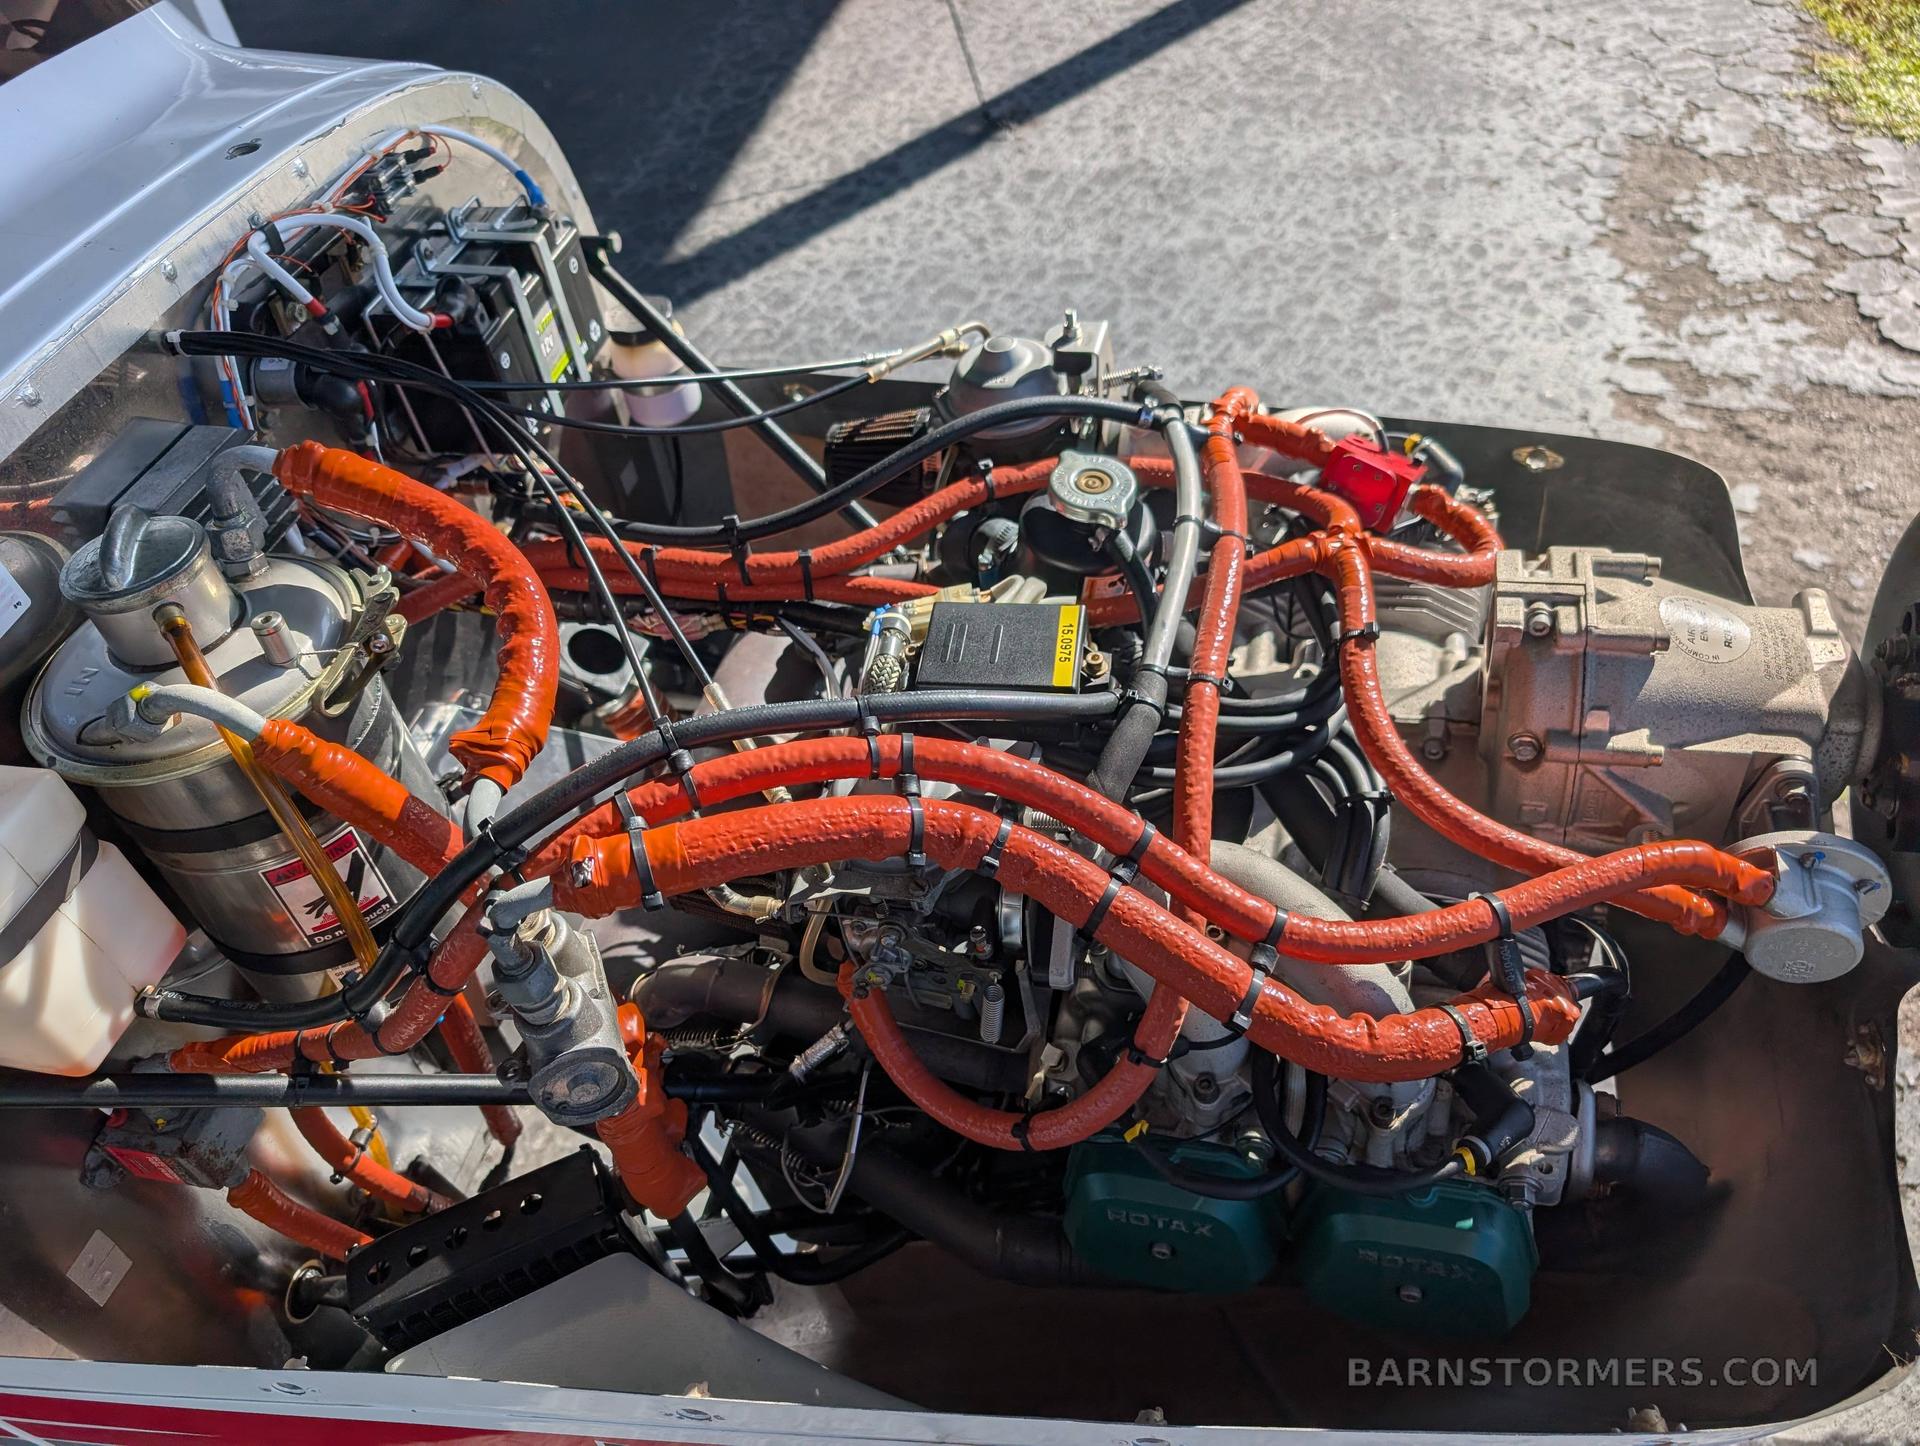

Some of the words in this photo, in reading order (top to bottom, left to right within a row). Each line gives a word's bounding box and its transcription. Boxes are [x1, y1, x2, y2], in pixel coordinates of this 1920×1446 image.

[1058, 623, 1074, 663] 15.0975
[313, 933, 332, 944] Do
[364, 902, 391, 924] ouch
[1105, 1207, 1215, 1239] ROTAX
